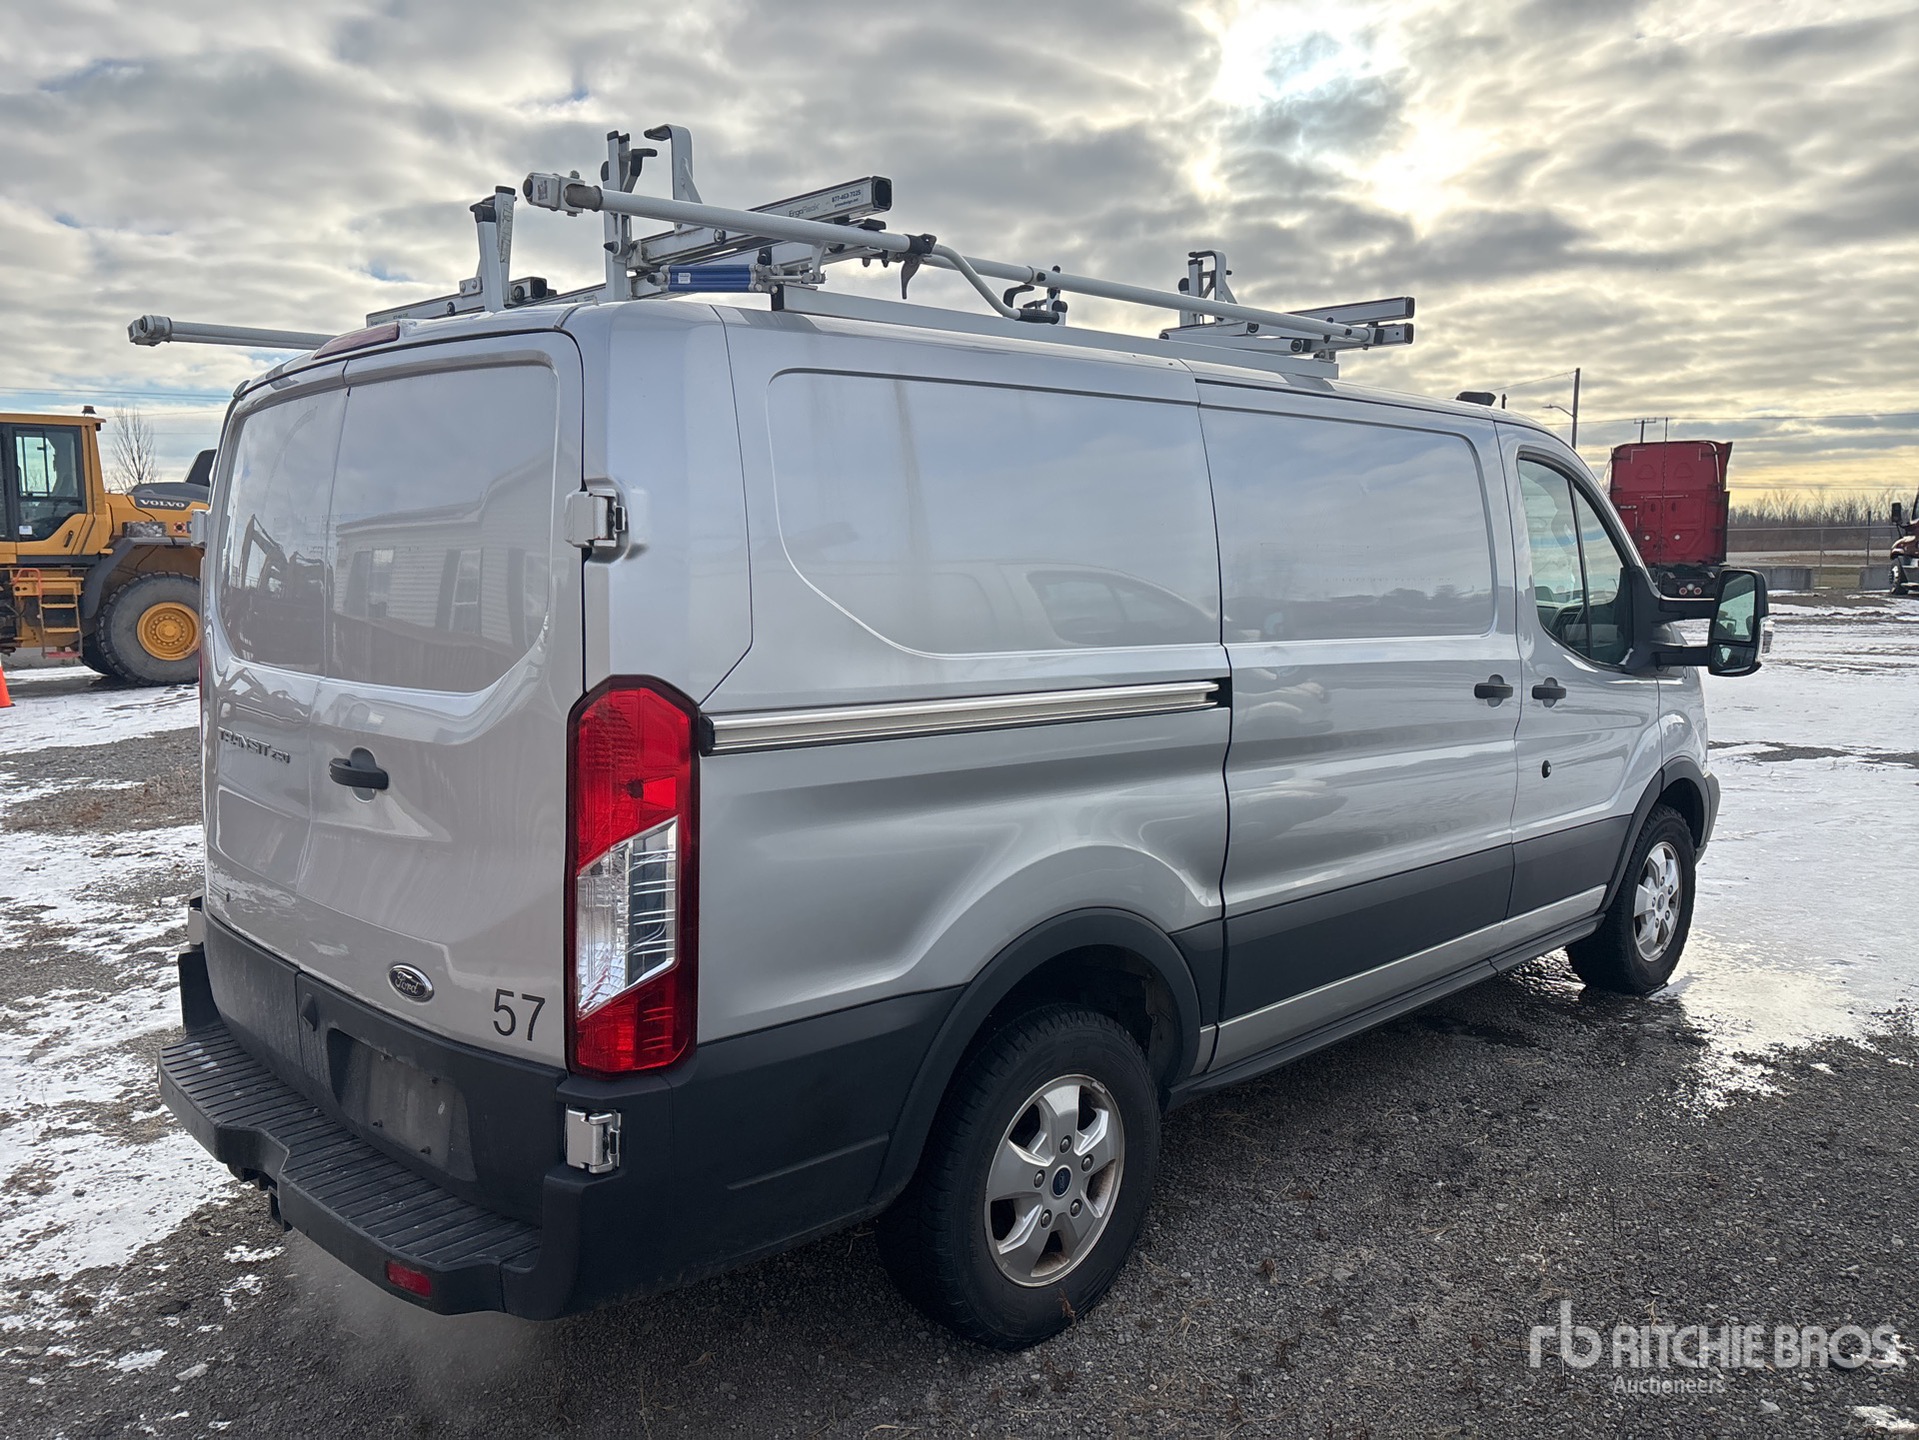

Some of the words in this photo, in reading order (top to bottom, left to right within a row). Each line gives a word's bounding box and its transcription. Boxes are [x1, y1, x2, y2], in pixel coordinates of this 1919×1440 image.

[140, 499, 185, 508] VOLVO
[395, 970, 422, 995] Ford
[493, 988, 546, 1042] 57
